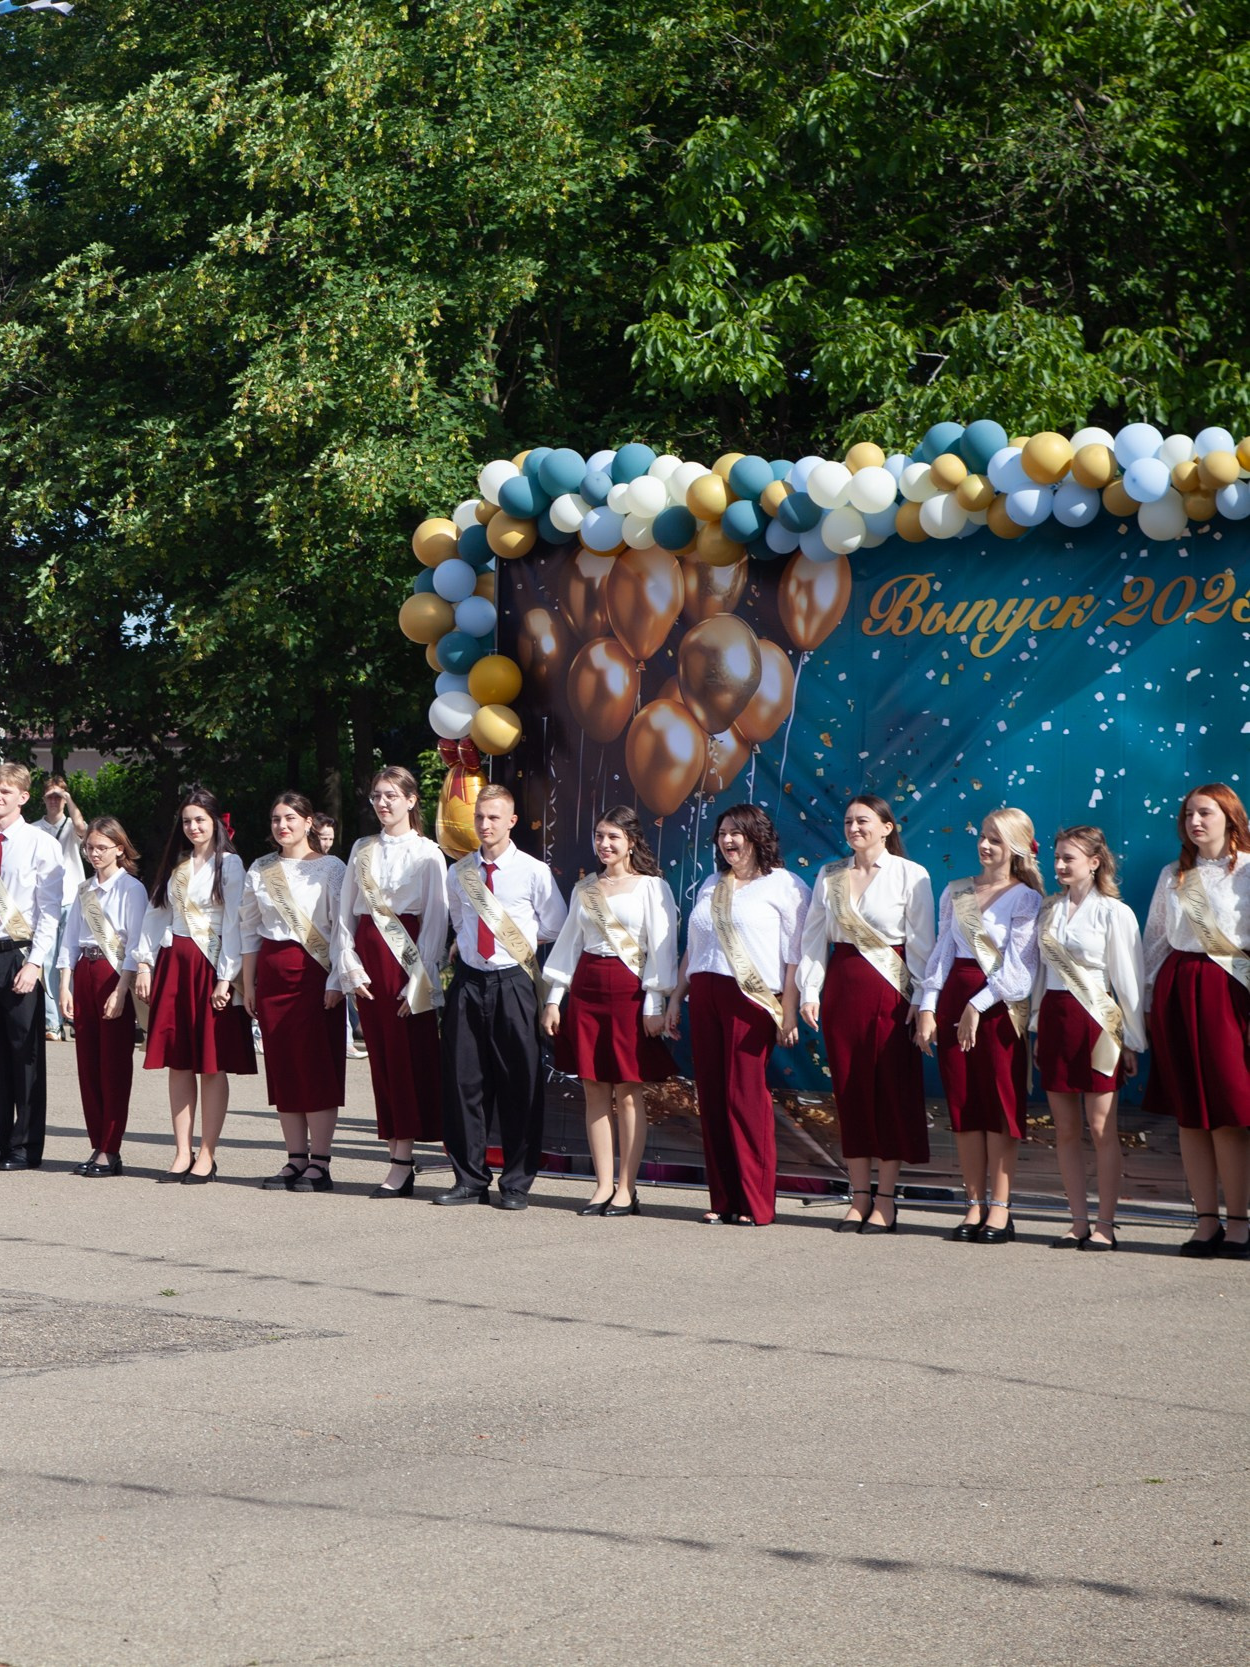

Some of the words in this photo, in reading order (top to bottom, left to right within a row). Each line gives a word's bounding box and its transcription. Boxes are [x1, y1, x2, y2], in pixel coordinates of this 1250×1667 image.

[861, 573, 1101, 659] Выпуск
[1105, 573, 1250, 627] 202
[463, 871, 501, 925] Выпускник
[502, 925, 527, 953] 2025
